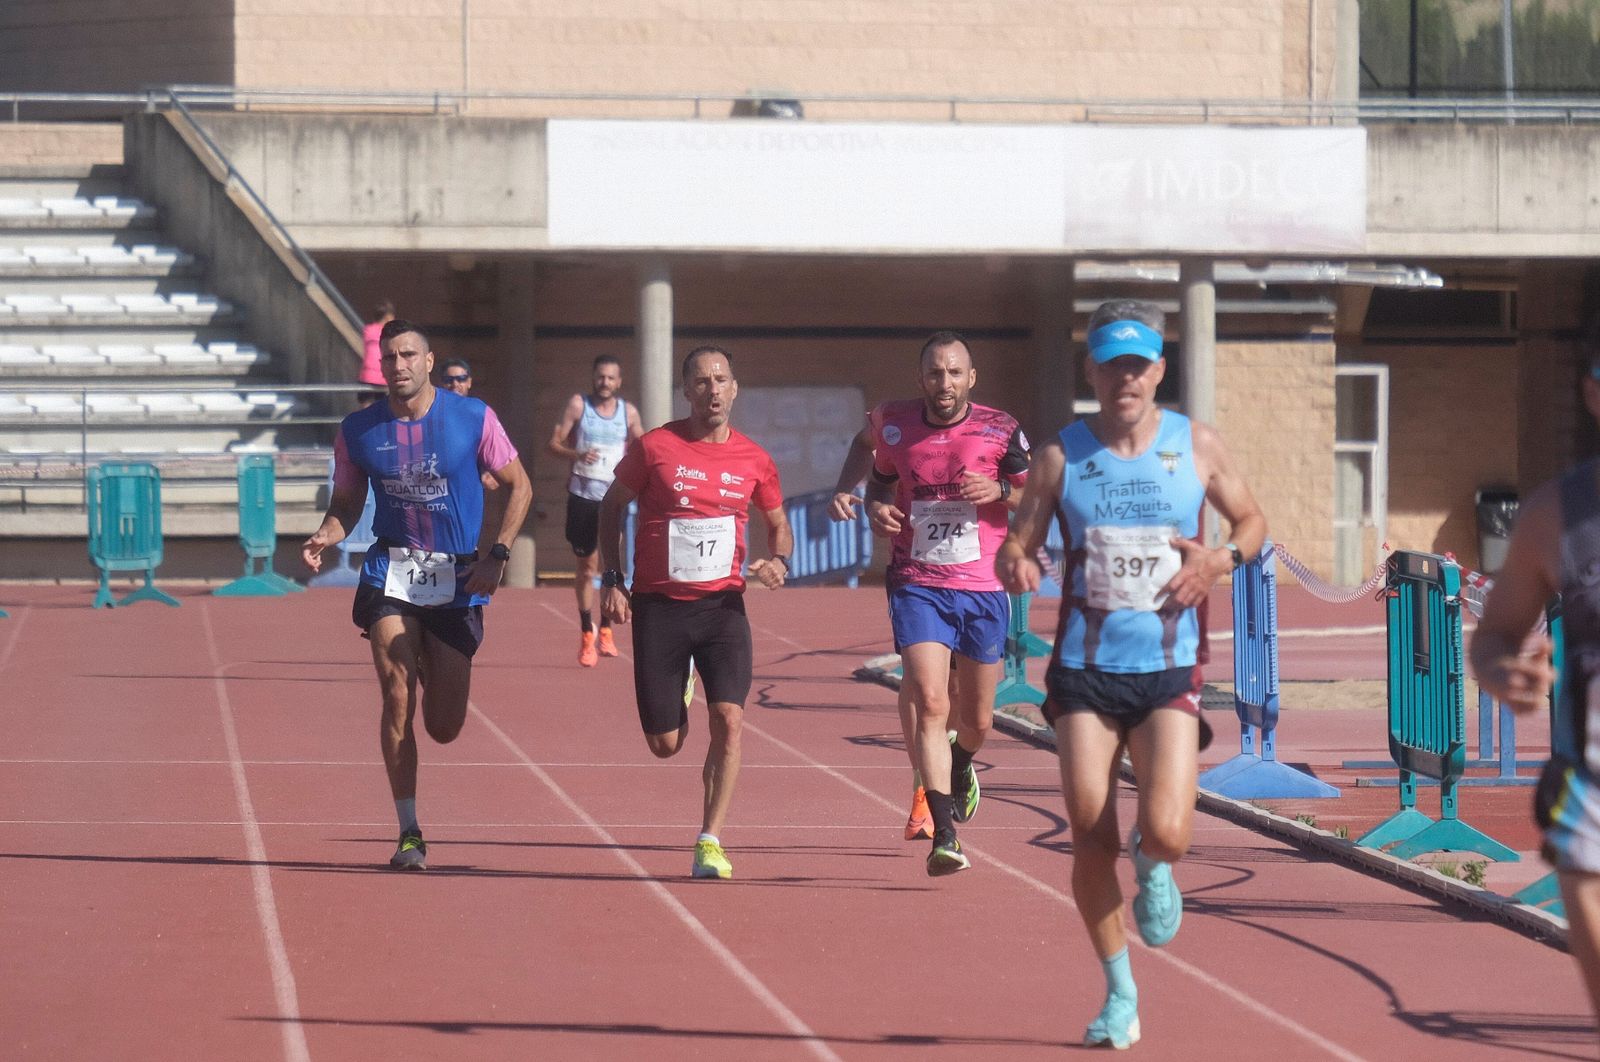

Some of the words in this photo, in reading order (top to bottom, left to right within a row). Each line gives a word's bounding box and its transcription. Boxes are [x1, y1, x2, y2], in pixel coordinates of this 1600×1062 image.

[927, 522, 964, 541] 274
[696, 540, 717, 557] 17
[1113, 556, 1160, 578] 397
[406, 568, 437, 587] 131
